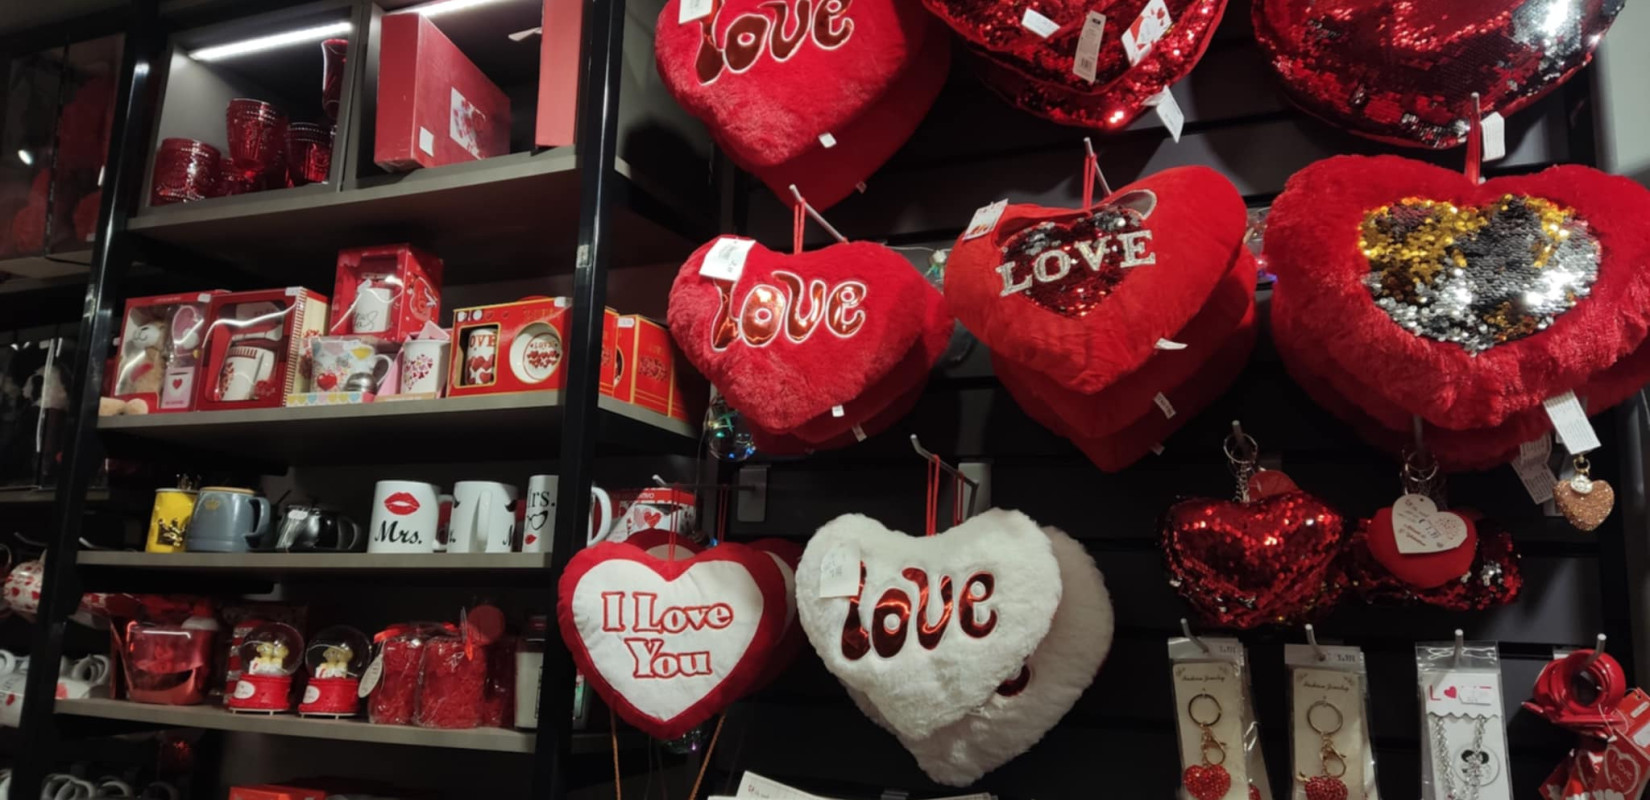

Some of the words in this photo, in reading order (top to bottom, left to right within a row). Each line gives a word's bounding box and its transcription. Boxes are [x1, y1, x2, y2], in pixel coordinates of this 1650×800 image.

[374, 520, 422, 545] Mrs.
[601, 591, 626, 632] I
[632, 591, 734, 634] Love
[624, 637, 713, 679] You
